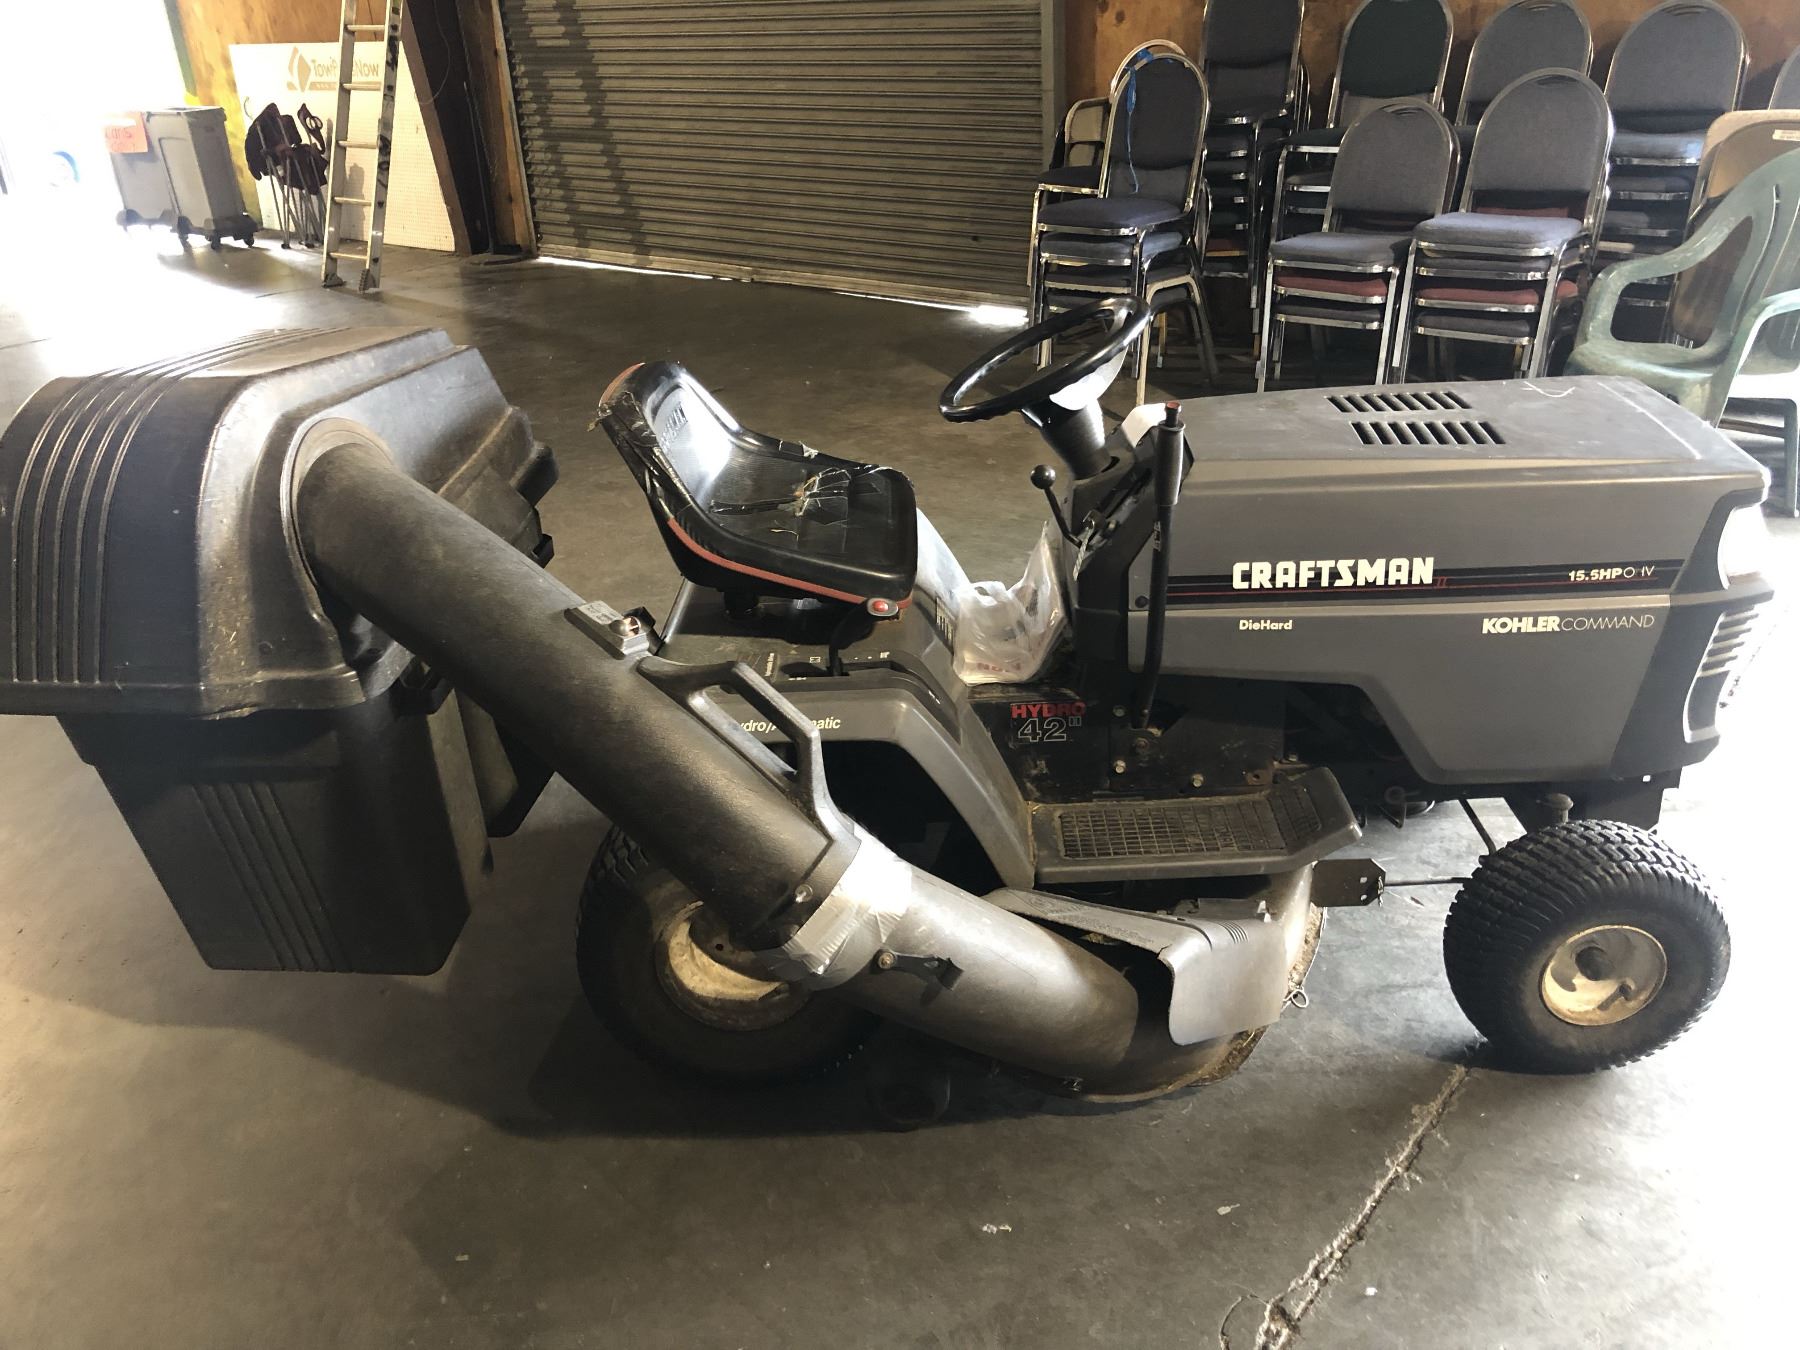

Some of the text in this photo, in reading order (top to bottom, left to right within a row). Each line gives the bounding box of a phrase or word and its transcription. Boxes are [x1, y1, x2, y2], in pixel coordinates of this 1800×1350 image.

[1232, 556, 1434, 590] CRAFTSMAN
[1239, 618, 1293, 631] DieHard
[1482, 614, 1655, 634] KOHLER COMMAND
[1011, 702, 1086, 719] HYDRO
